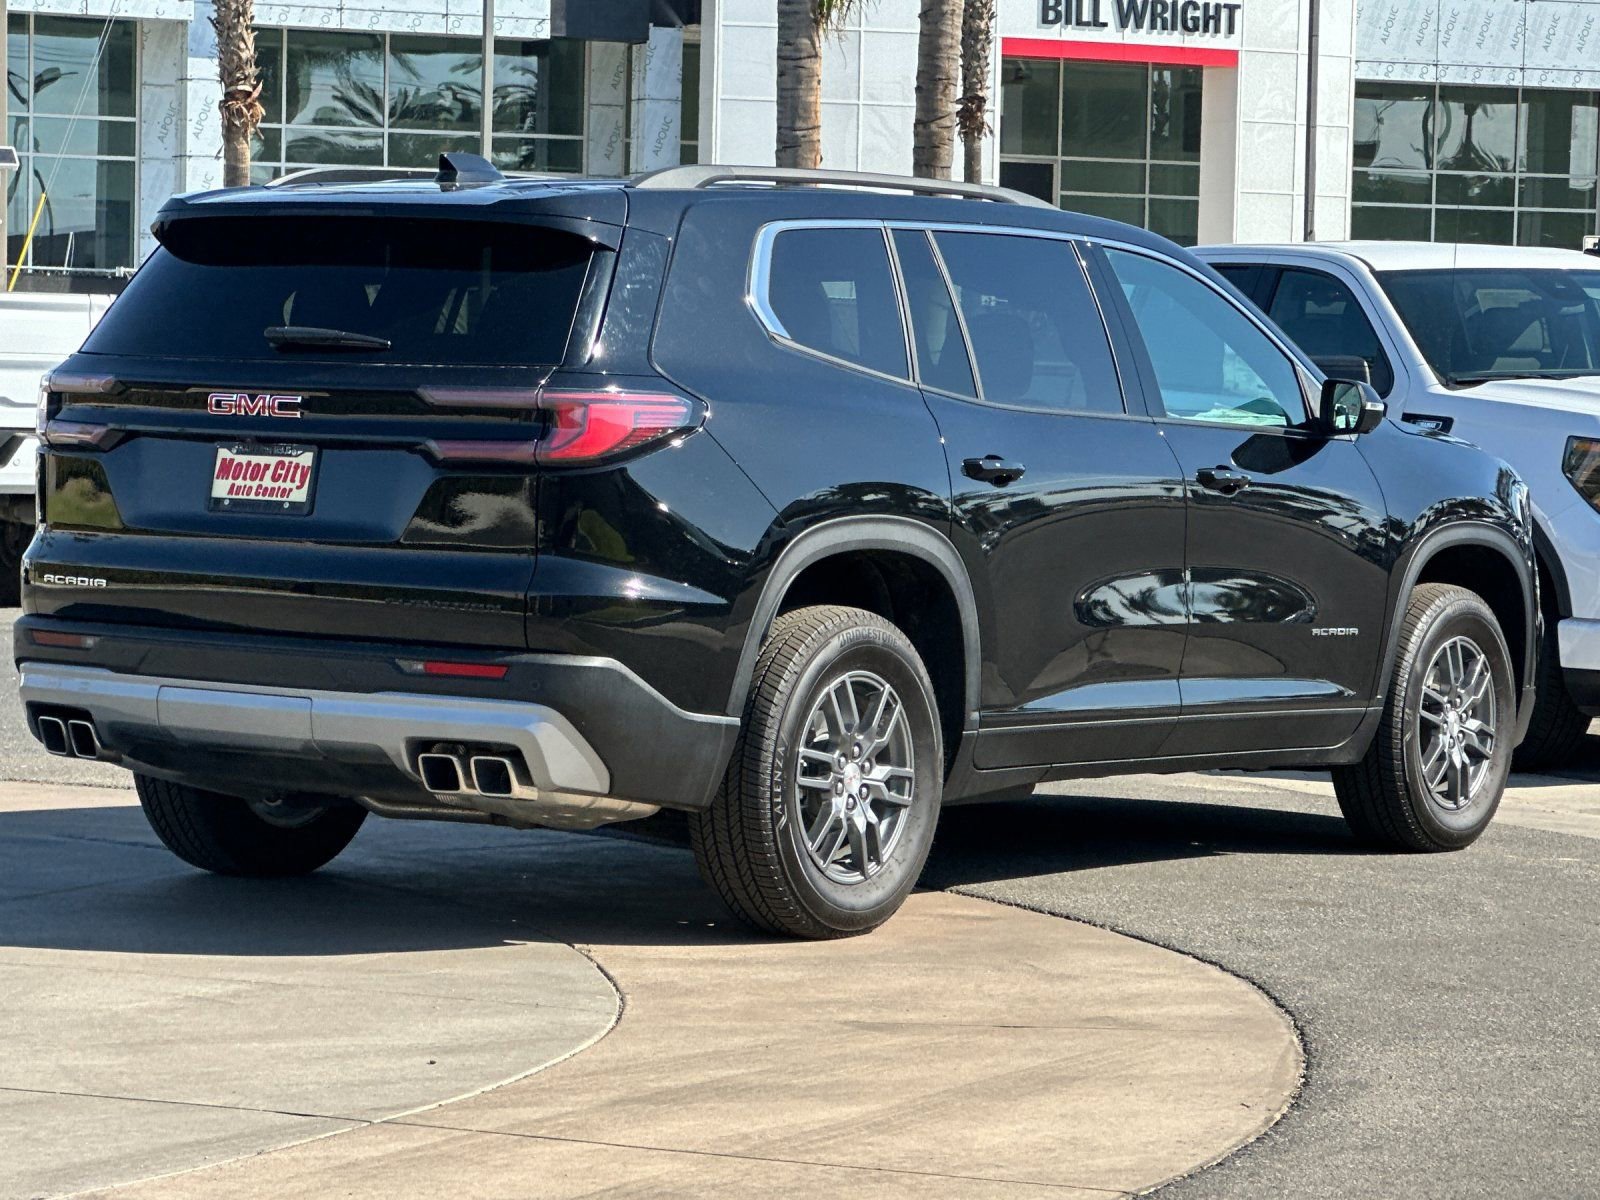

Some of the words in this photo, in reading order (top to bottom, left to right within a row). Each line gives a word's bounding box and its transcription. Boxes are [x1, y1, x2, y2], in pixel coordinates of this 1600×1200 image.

[1042, 0, 1108, 27] BILL
[1117, 0, 1241, 35] WRIGHT
[1380, 6, 1399, 45] ALPOLIC
[1415, 7, 1434, 46] ALPOLIC
[1441, 8, 1460, 48] ALPOLIC
[1475, 9, 1494, 50] ALPOLIC
[1542, 10, 1561, 52] ALPOLIC
[1576, 14, 1595, 54] ALPOLIC
[157, 101, 178, 143] ALPOLIC
[192, 96, 215, 140] ALPOLIC
[652, 116, 673, 157] ALPOLIC
[604, 120, 623, 160] ALPOLIC
[207, 393, 302, 418] GMC
[215, 457, 271, 481] Motor
[270, 459, 311, 490] City
[227, 483, 253, 497] Auto
[254, 484, 293, 499] Center
[43, 573, 107, 588] ACADIA
[838, 627, 899, 648] BRIDGESTONE
[1311, 627, 1359, 636] ACADIA
[773, 746, 786, 815] ALENZA
